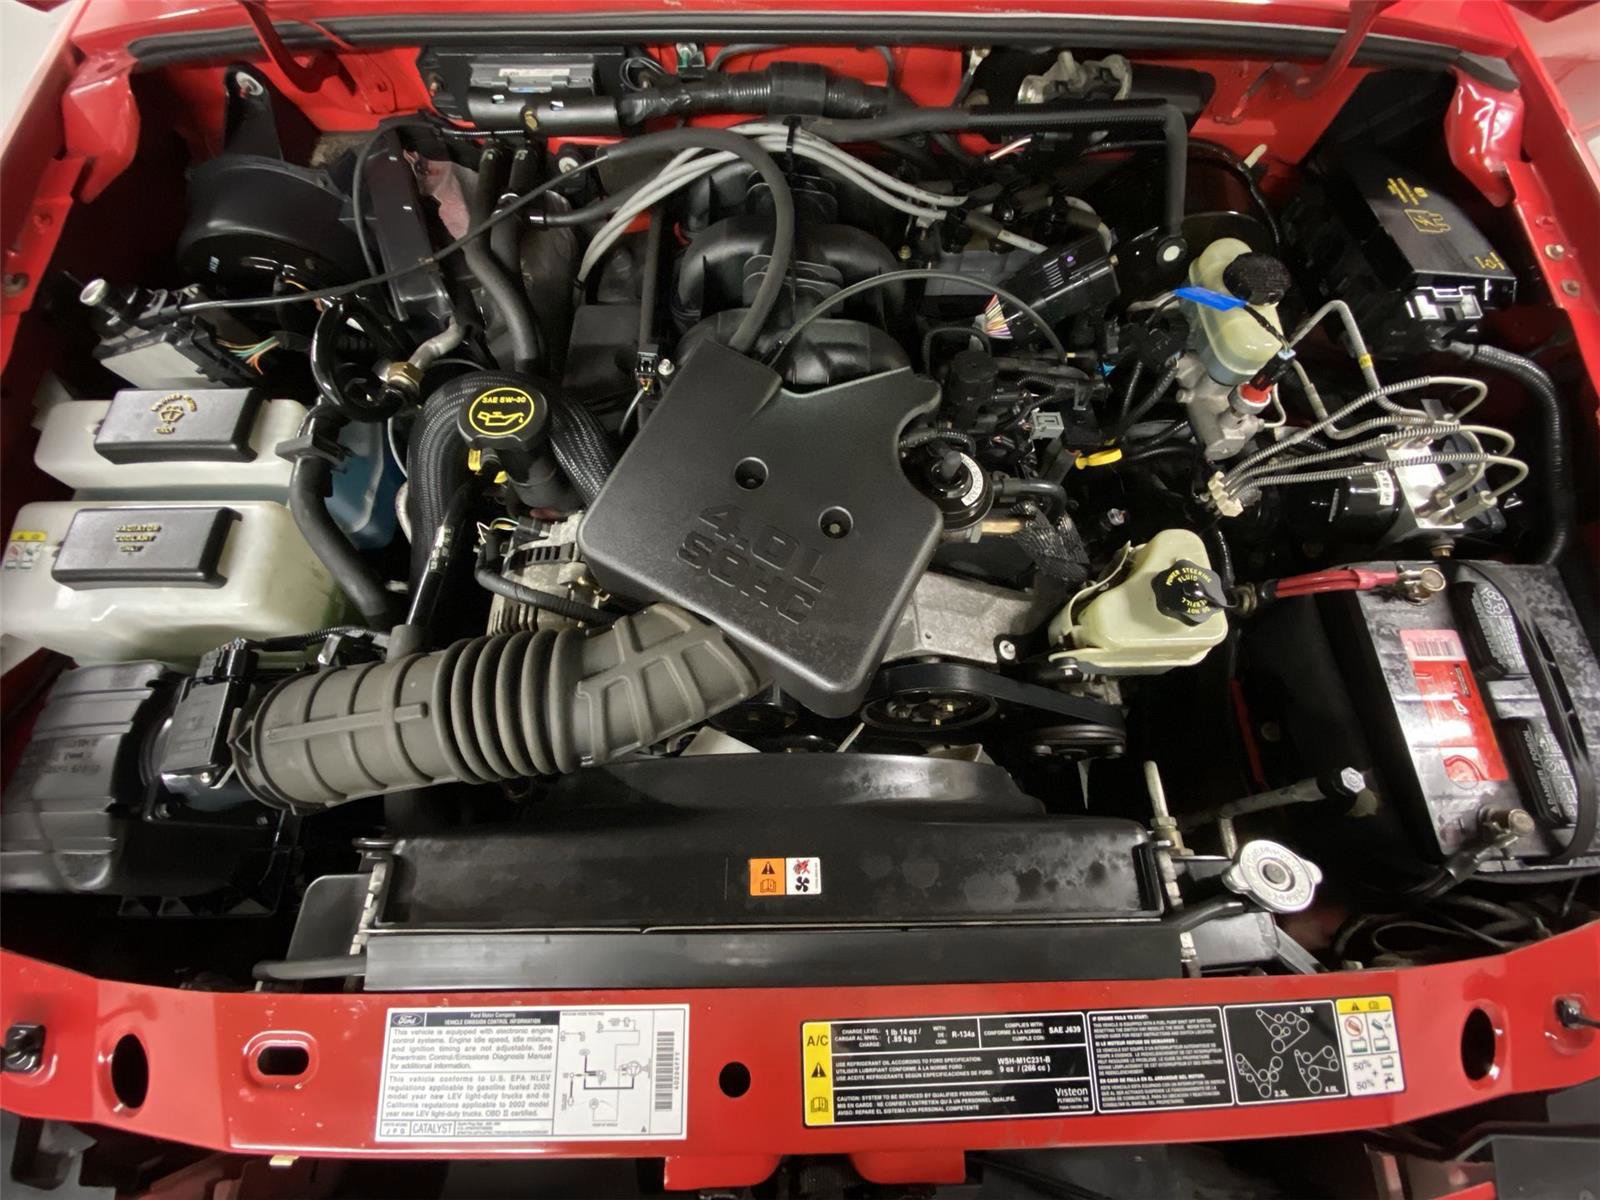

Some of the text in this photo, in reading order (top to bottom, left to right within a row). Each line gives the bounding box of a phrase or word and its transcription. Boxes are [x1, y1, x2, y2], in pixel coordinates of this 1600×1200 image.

[676, 530, 816, 625] SOHC
[1178, 574, 1198, 584] FLUID
[1182, 568, 1212, 584] STEERING
[951, 1030, 975, 1038] R-134a
[807, 1036, 828, 1046] A/C
[997, 1055, 1051, 1065] WSH-M1C231-B
[1354, 1061, 1372, 1070] 50%
[1357, 1080, 1375, 1090] 50%
[1054, 1086, 1088, 1096] Visteon
[412, 1123, 453, 1134] CATALYST
